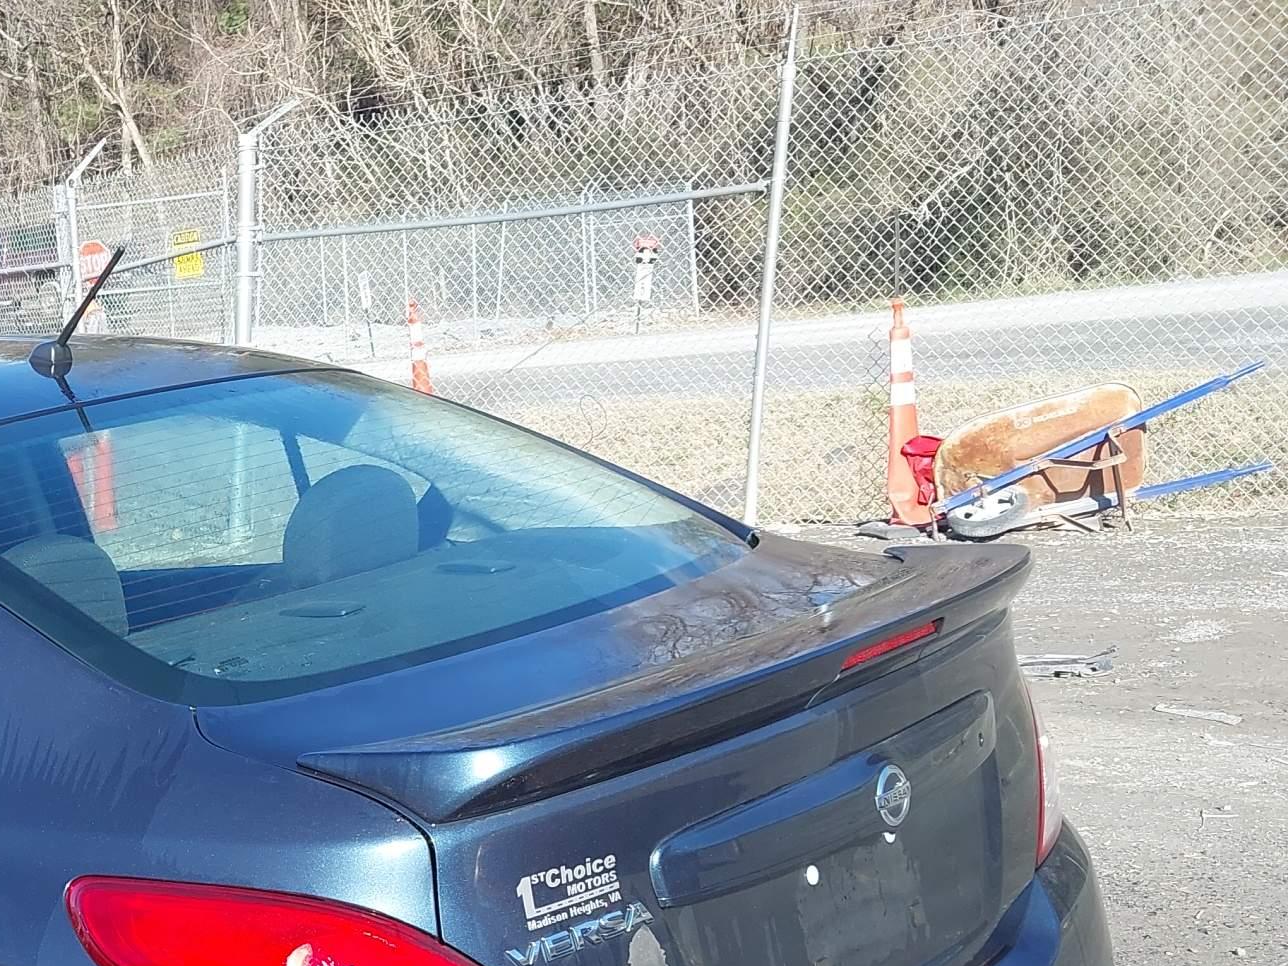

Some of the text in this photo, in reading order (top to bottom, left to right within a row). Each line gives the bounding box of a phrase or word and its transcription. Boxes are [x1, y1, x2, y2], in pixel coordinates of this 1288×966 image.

[80, 253, 108, 273] STOP
[546, 854, 616, 888] Choice
[567, 871, 617, 896] MOTORS
[527, 891, 622, 931] Madison Heights, VA
